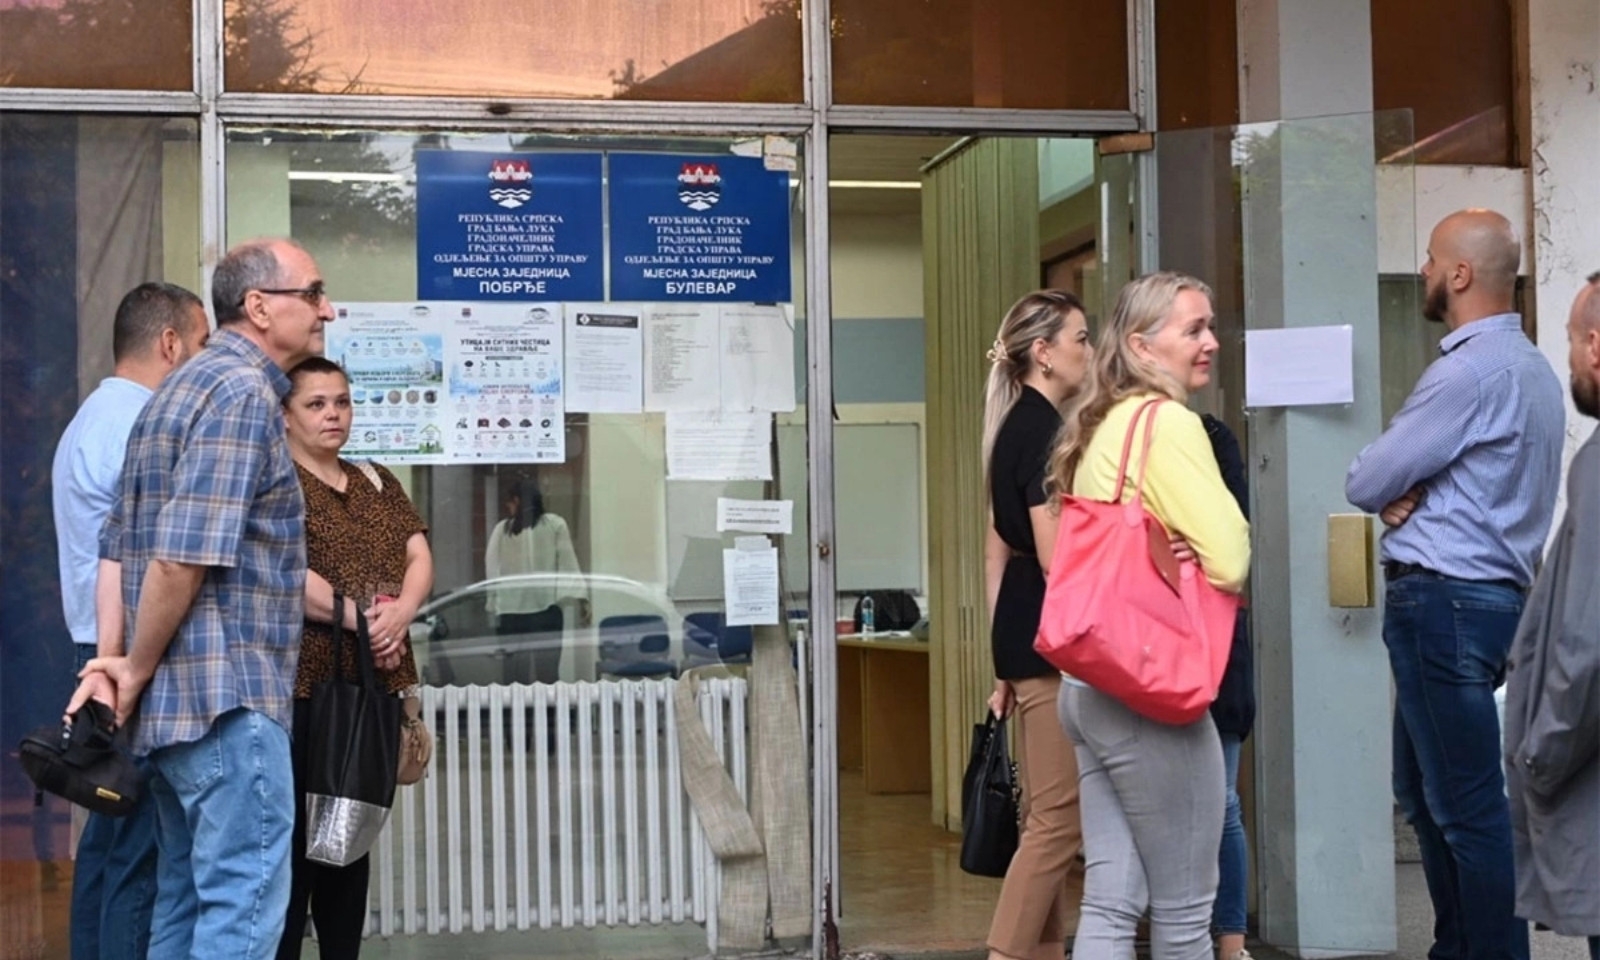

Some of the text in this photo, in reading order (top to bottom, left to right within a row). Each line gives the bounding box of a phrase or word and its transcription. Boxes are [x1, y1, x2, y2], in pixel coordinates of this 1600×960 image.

[458, 214, 564, 223] РЕПУБЛИКА СРПСКА
[648, 216, 751, 225] РЕПУБЛИКА СРПСКА
[467, 224, 555, 234] ГРАД БАЊА ЛУКА
[656, 226, 743, 235] ГРАД БАЊА ЛУКА
[467, 234, 556, 244] ГРАДОНАЧЕЛНИК
[657, 236, 743, 245] ГРАДОНАЧЕЛНИК
[468, 244, 555, 253] ГРАДСКА УПРАВА
[657, 245, 743, 255] ГРАДСКА УПРАВА
[434, 254, 589, 264] ОДЈЕЉЕЊЕ ЗА ОПШТУ УПРАВУ
[624, 256, 775, 265] ОДЈЕЉЕЊЕ ЗА ОПШТУ УПРАВУ
[453, 267, 571, 280] МЈЕСНА ЗАЈЕДНИЦА
[643, 268, 757, 281] МЈЕСНА ЗАЈЕДНИЦА
[479, 281, 547, 294] ПОБРЂЕ
[666, 281, 737, 295] БУЛЕВАР
